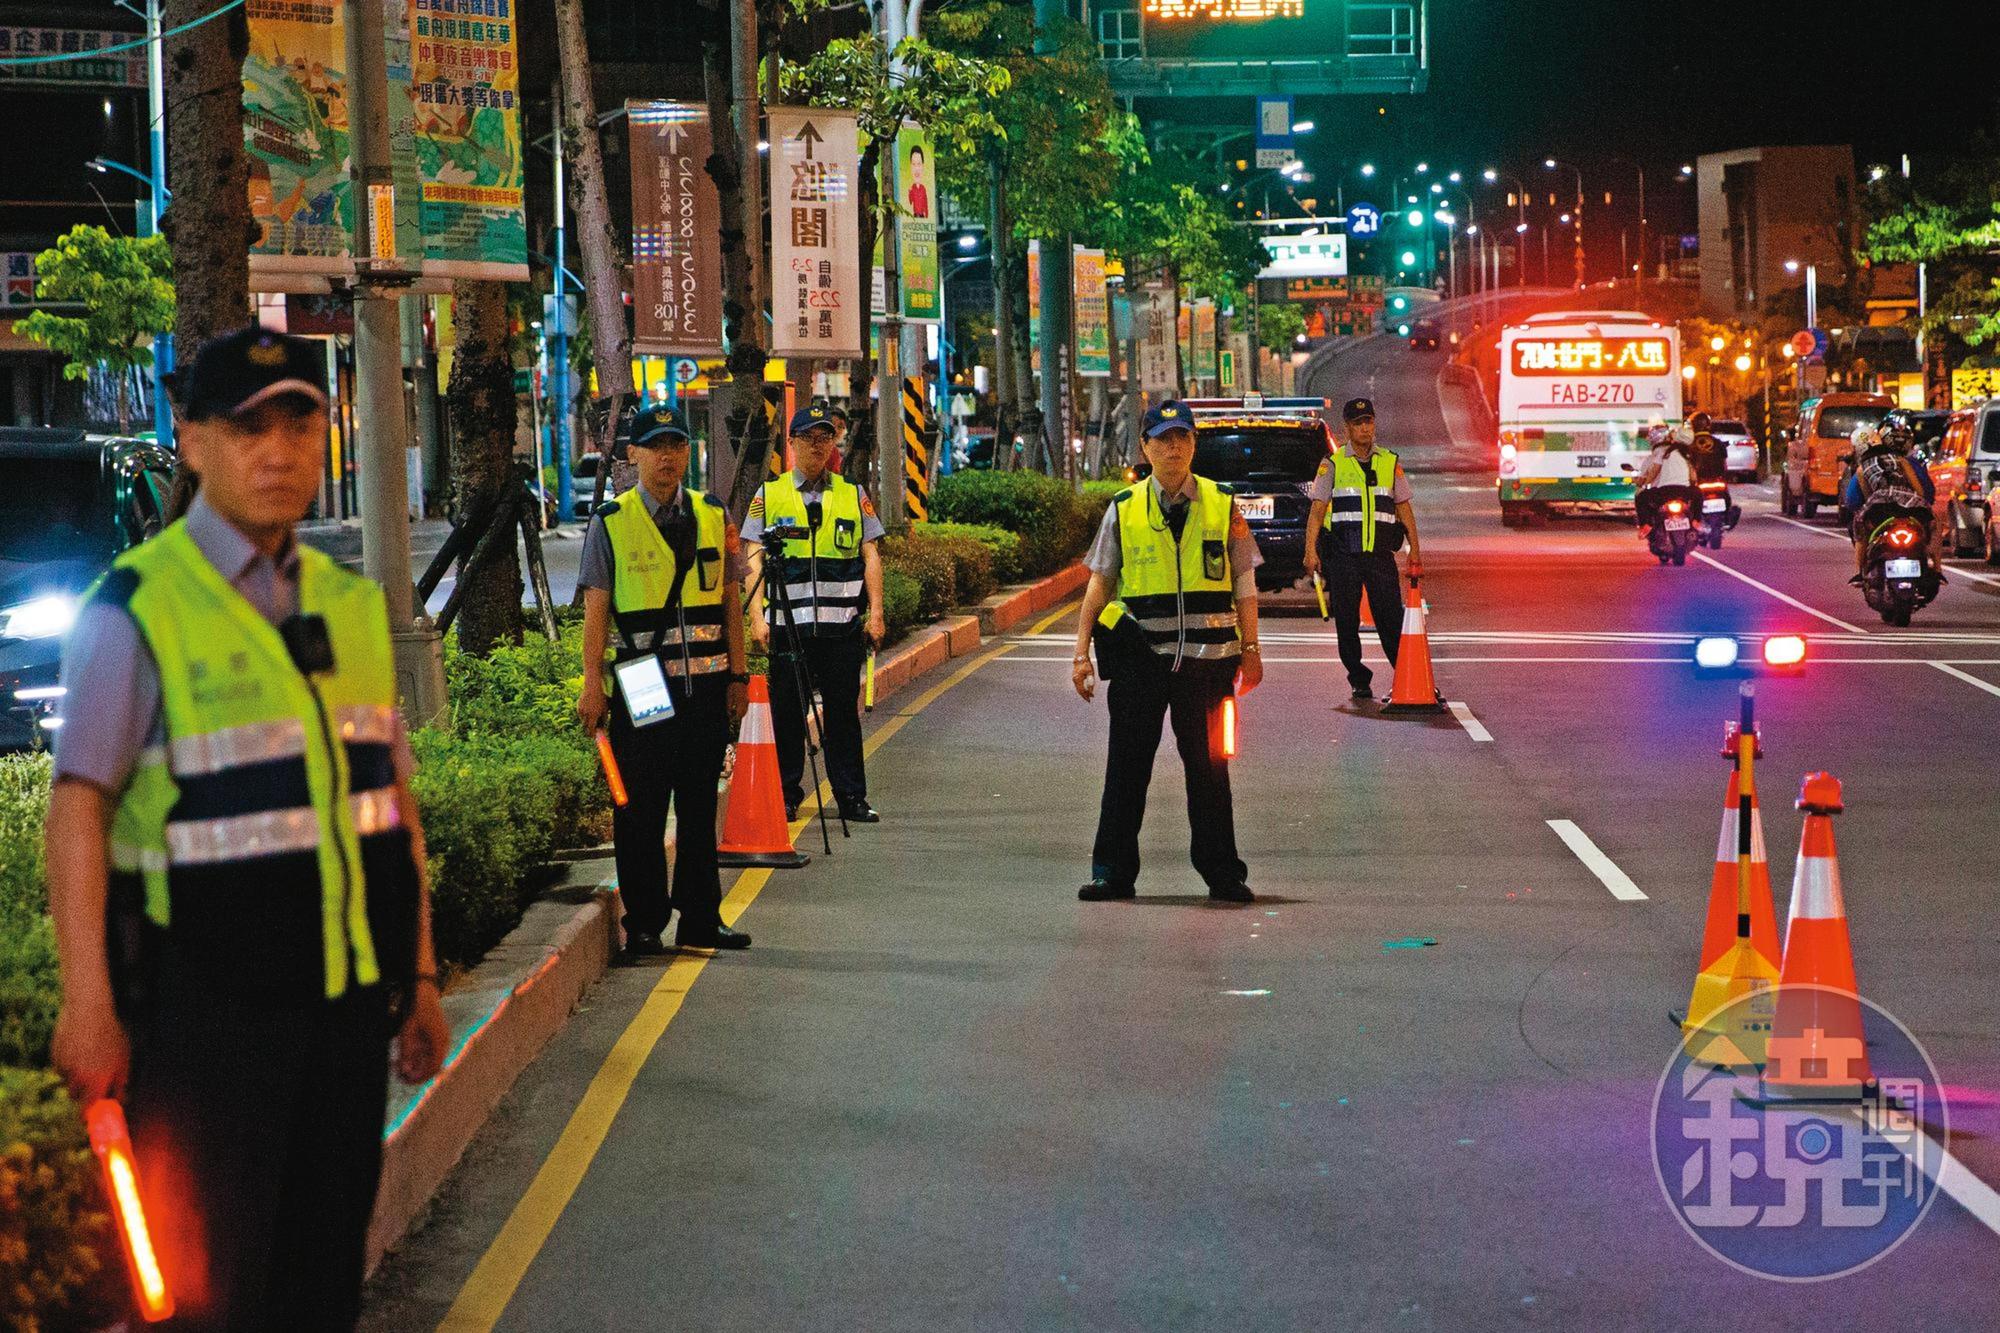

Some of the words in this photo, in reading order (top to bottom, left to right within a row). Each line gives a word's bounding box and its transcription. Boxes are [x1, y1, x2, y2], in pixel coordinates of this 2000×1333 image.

[417, 15, 511, 43] 龍舟現場嘉年華
[418, 42, 512, 70] 仲夏夜音樂饗宴
[419, 82, 514, 109] 現場大獎等你拿
[1551, 384, 1635, 403] FAB-270
[1236, 503, 1272, 517] S7161
